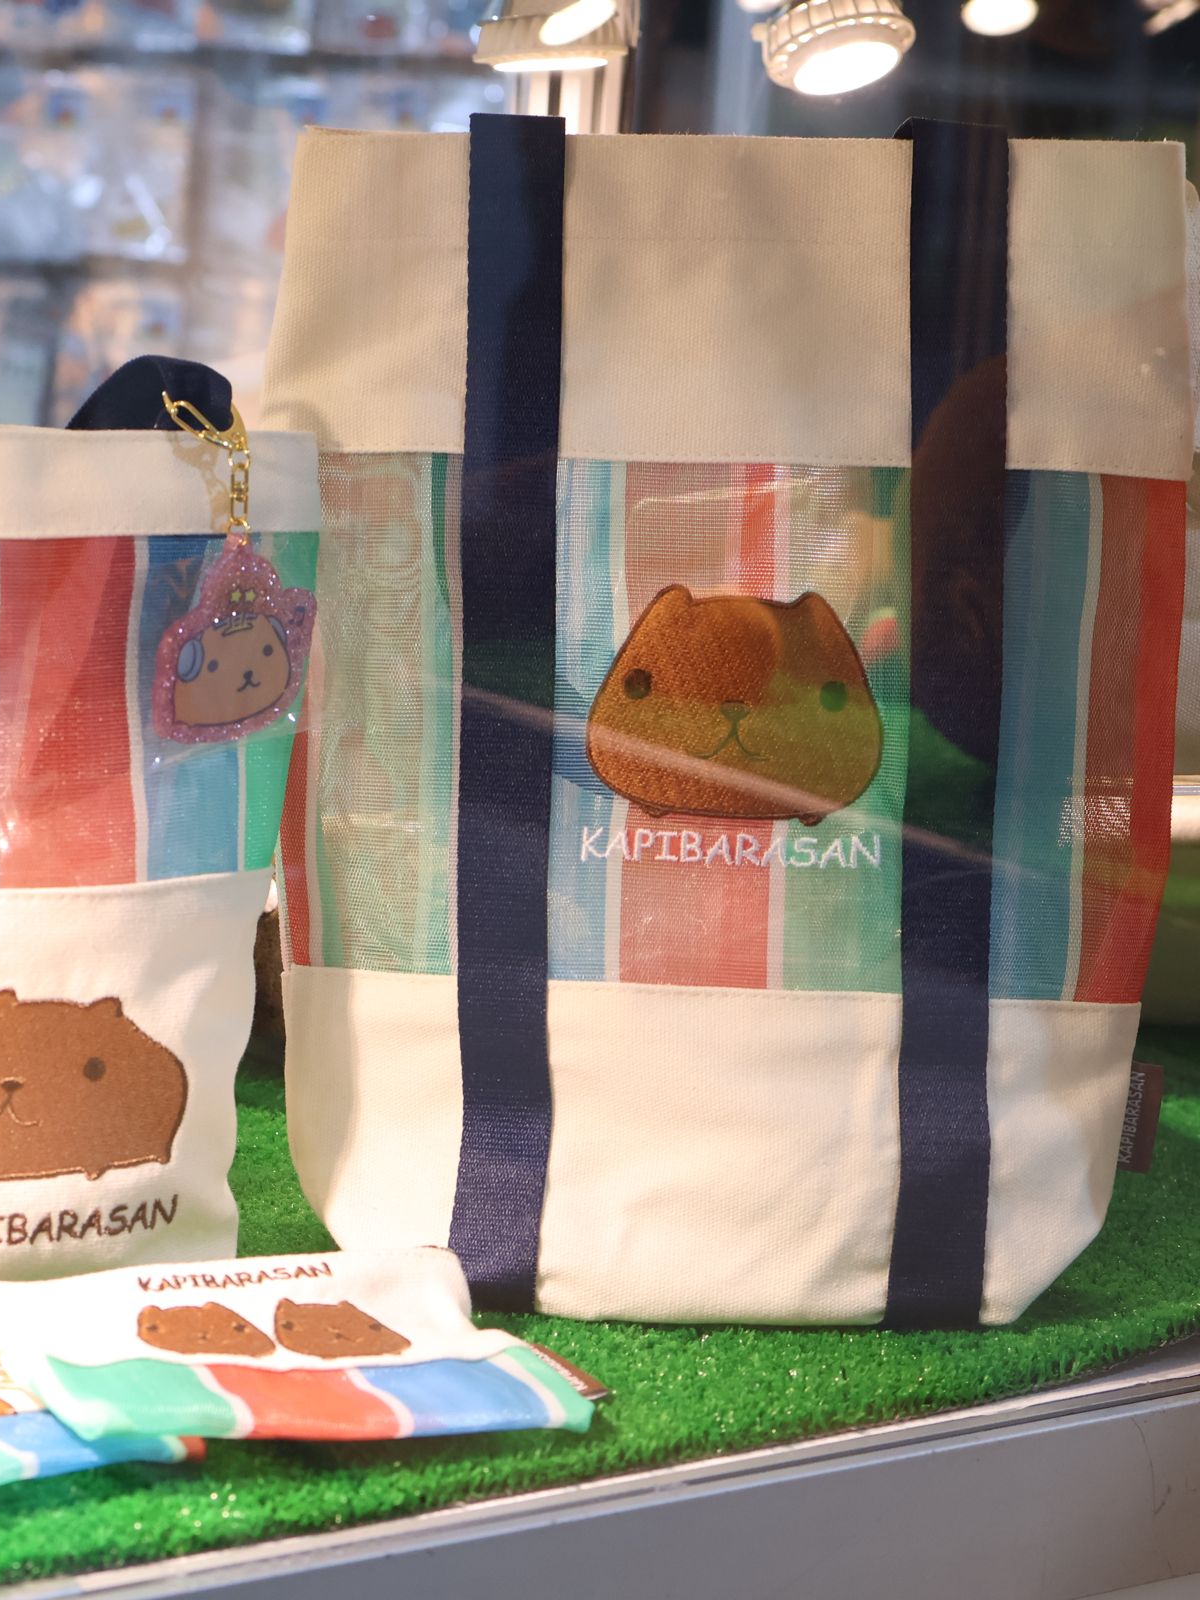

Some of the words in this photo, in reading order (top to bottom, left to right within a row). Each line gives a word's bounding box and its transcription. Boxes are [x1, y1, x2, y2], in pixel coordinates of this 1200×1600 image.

[581, 825, 881, 869] KAPIBARASAN
[1118, 1071, 1146, 1164] KAPIBARASAN
[137, 1262, 333, 1293] KAPIBARASAN
